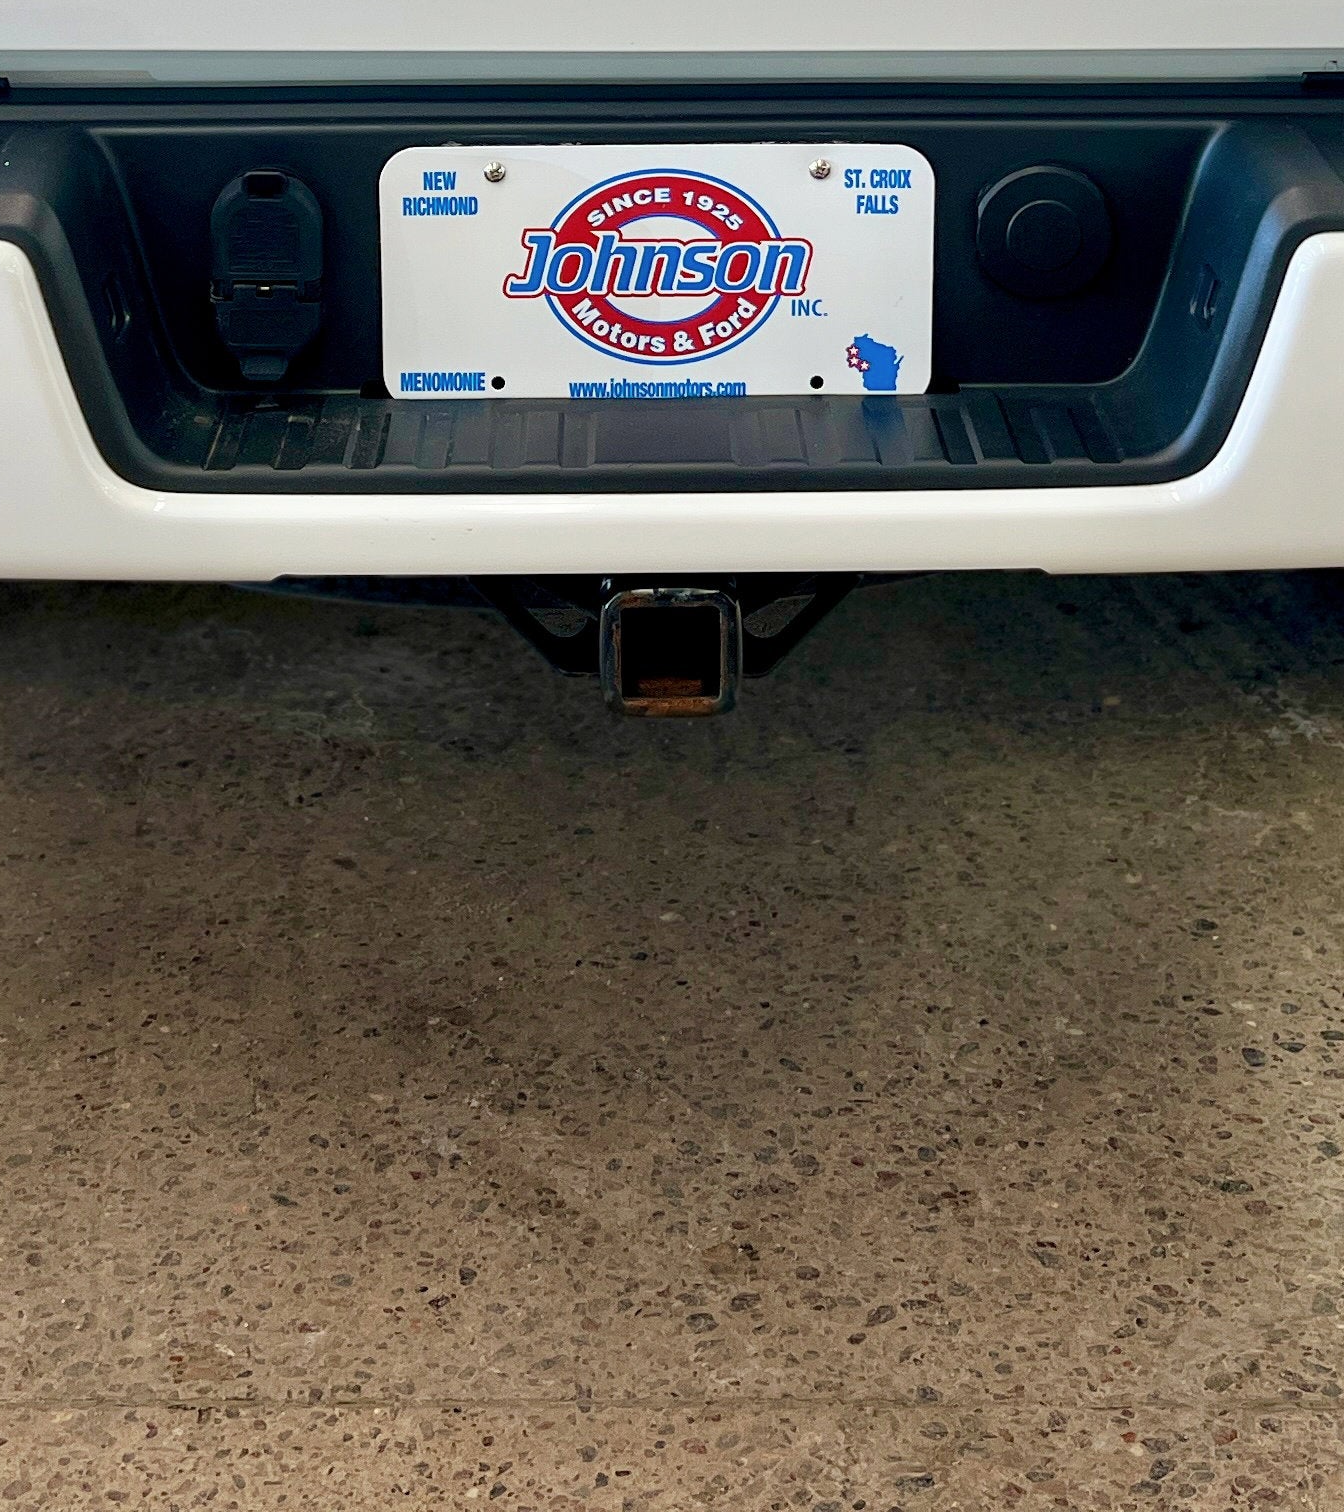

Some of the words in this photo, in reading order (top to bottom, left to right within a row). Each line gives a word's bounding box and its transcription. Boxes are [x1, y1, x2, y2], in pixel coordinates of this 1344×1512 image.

[423, 171, 457, 191] NEW
[844, 168, 866, 189] ST.
[869, 168, 912, 189] CROIX
[402, 196, 479, 216] RICHMOND
[586, 187, 671, 228] SINCE
[682, 190, 744, 232] 1925
[856, 194, 899, 214] FALLS
[506, 231, 810, 295] Johnson
[791, 299, 829, 318] INC.
[571, 297, 667, 354] Motors
[672, 330, 696, 352] &
[697, 295, 758, 346] Ford
[400, 372, 486, 392] MENOMONIE
[568, 378, 747, 398] www.johnsonmotors.com
